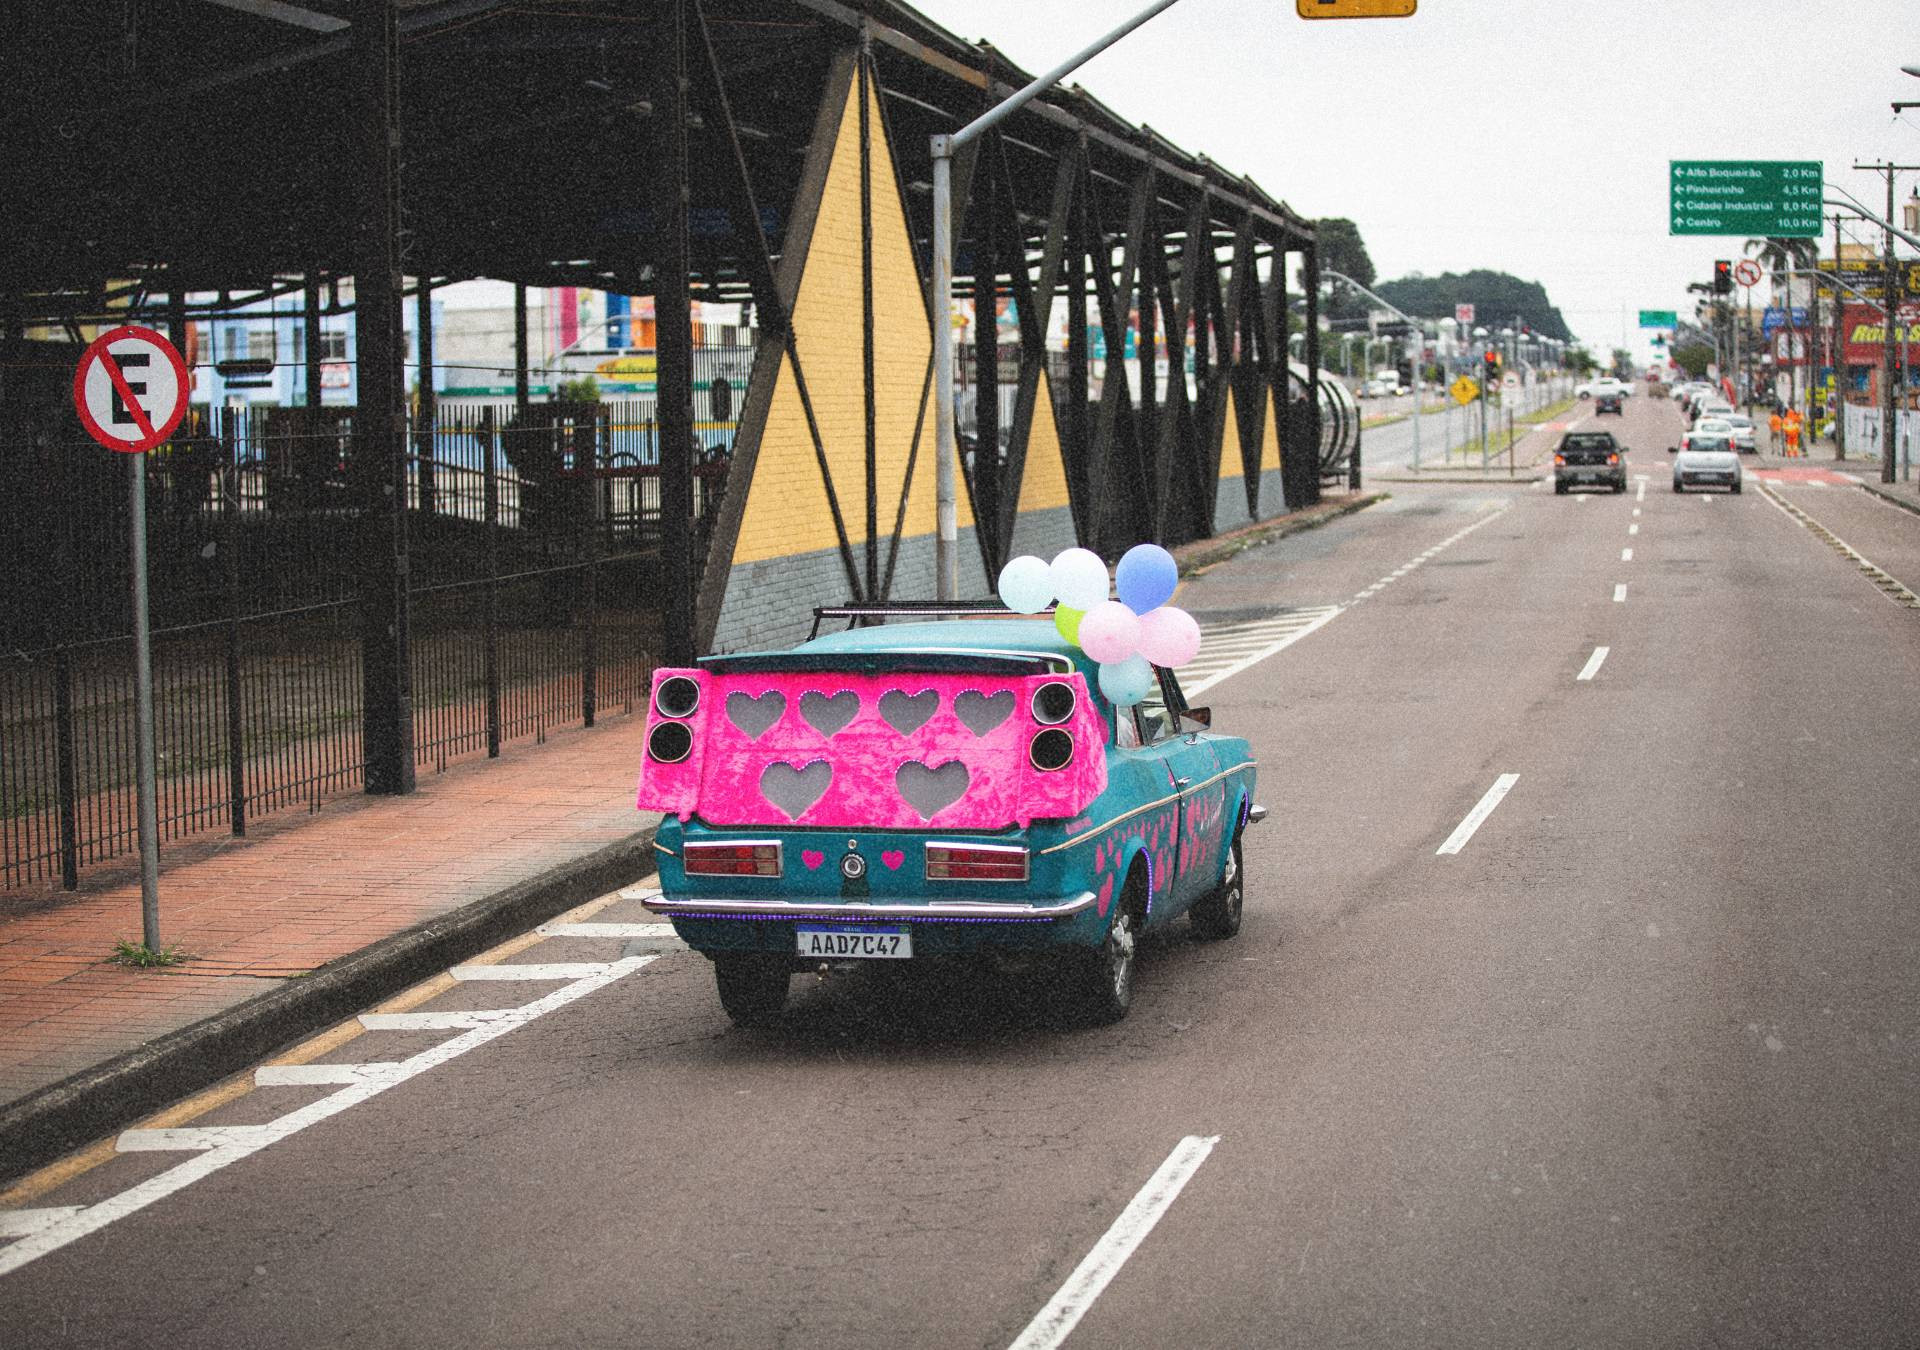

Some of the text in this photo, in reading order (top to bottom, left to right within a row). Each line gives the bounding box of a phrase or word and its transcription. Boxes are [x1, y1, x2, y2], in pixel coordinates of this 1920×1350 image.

[1687, 167, 1762, 179] Alto Boqueirão
[1783, 168, 1818, 179] 2,0 Km
[1687, 184, 1744, 194] Pinheirinho
[1801, 185, 1818, 195] Km
[1687, 201, 1773, 211] Cidade Industrial
[1801, 202, 1818, 211] Km
[1687, 217, 1721, 227] Centro
[1778, 218, 1819, 229] 10,0 Km
[111, 353, 151, 424] E
[811, 934, 900, 954] AAD7C47
